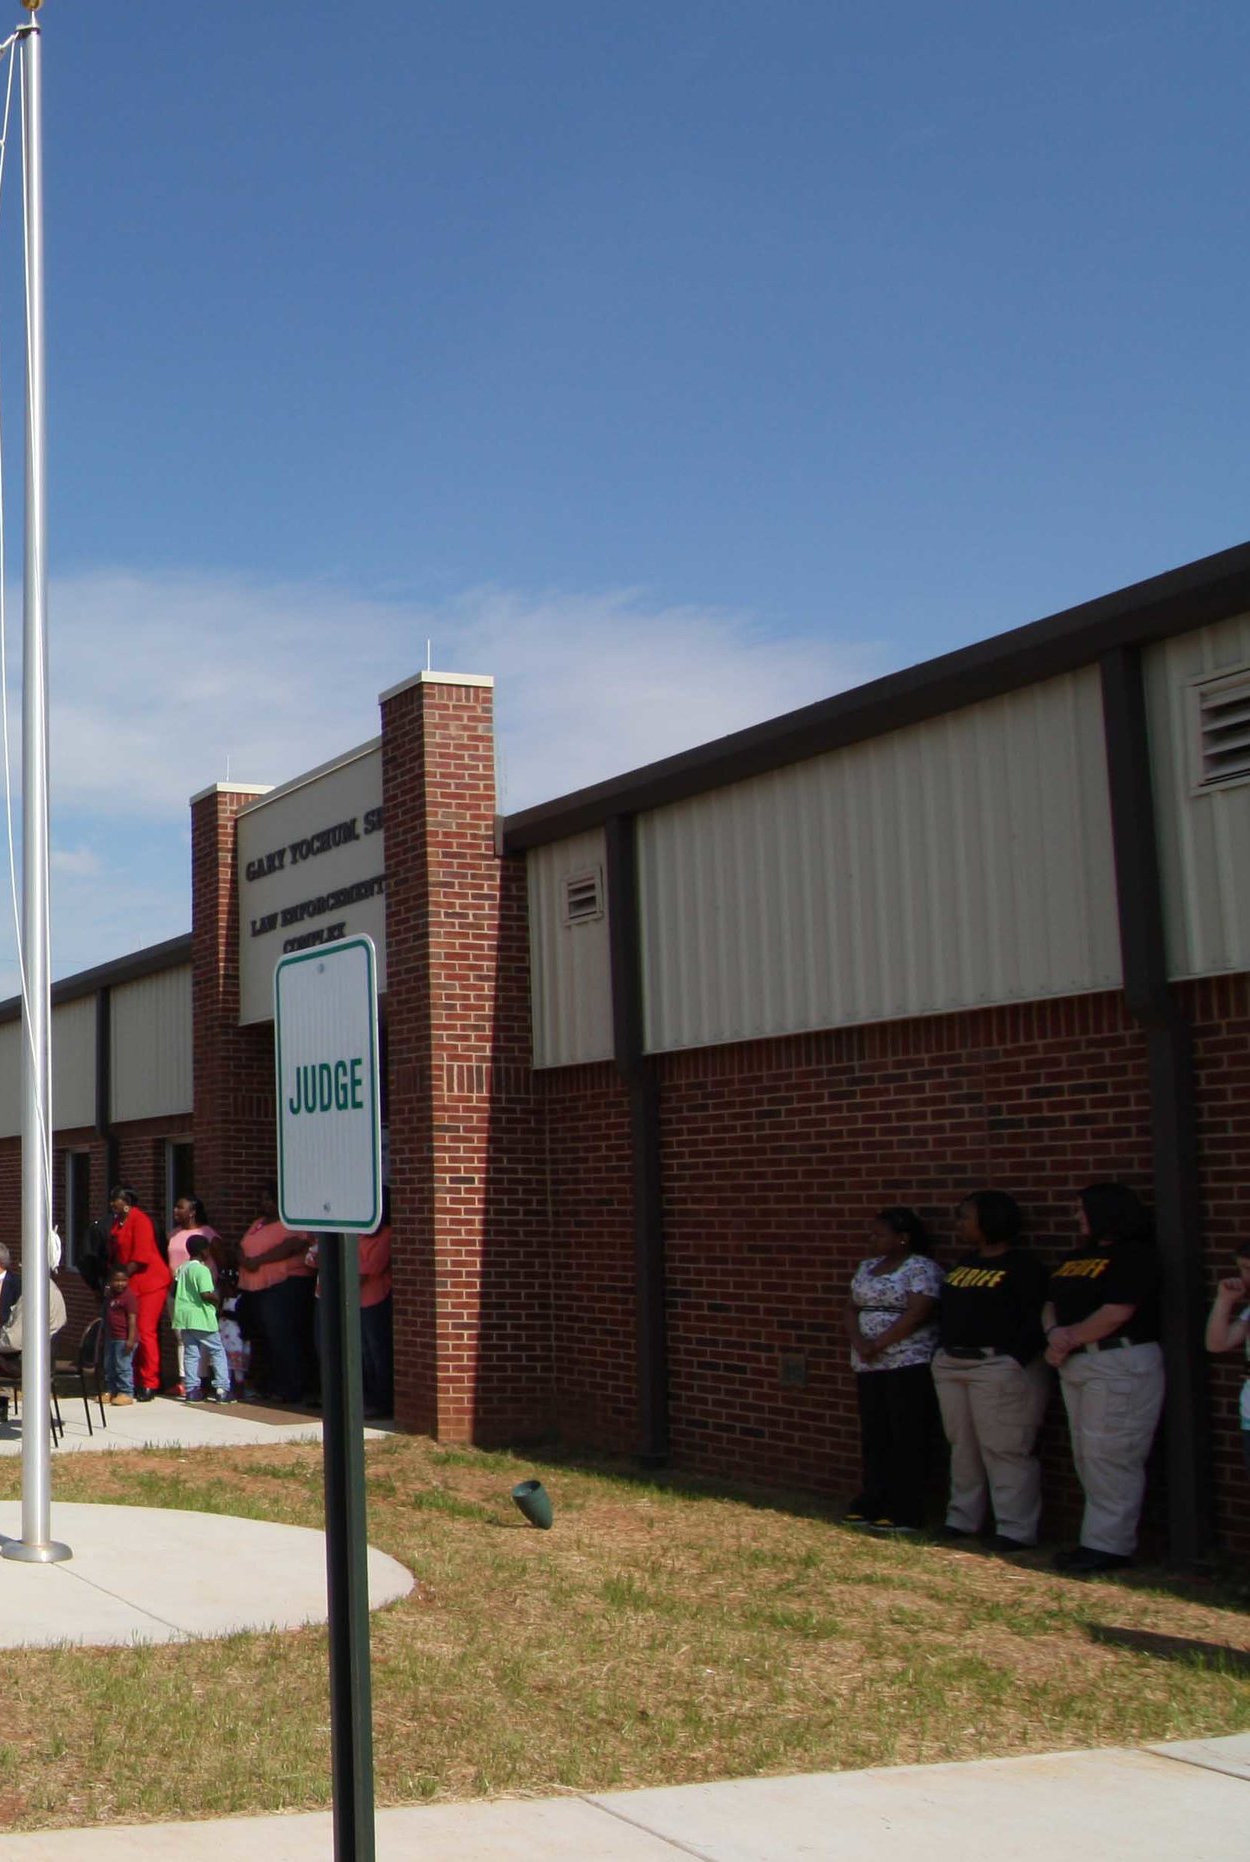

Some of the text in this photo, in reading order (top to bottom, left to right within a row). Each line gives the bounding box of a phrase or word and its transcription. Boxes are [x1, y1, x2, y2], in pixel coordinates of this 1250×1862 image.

[246, 848, 286, 882] GARY
[250, 875, 386, 937] LAW ENFORCEMENT
[290, 1058, 364, 1115] JUDGE
